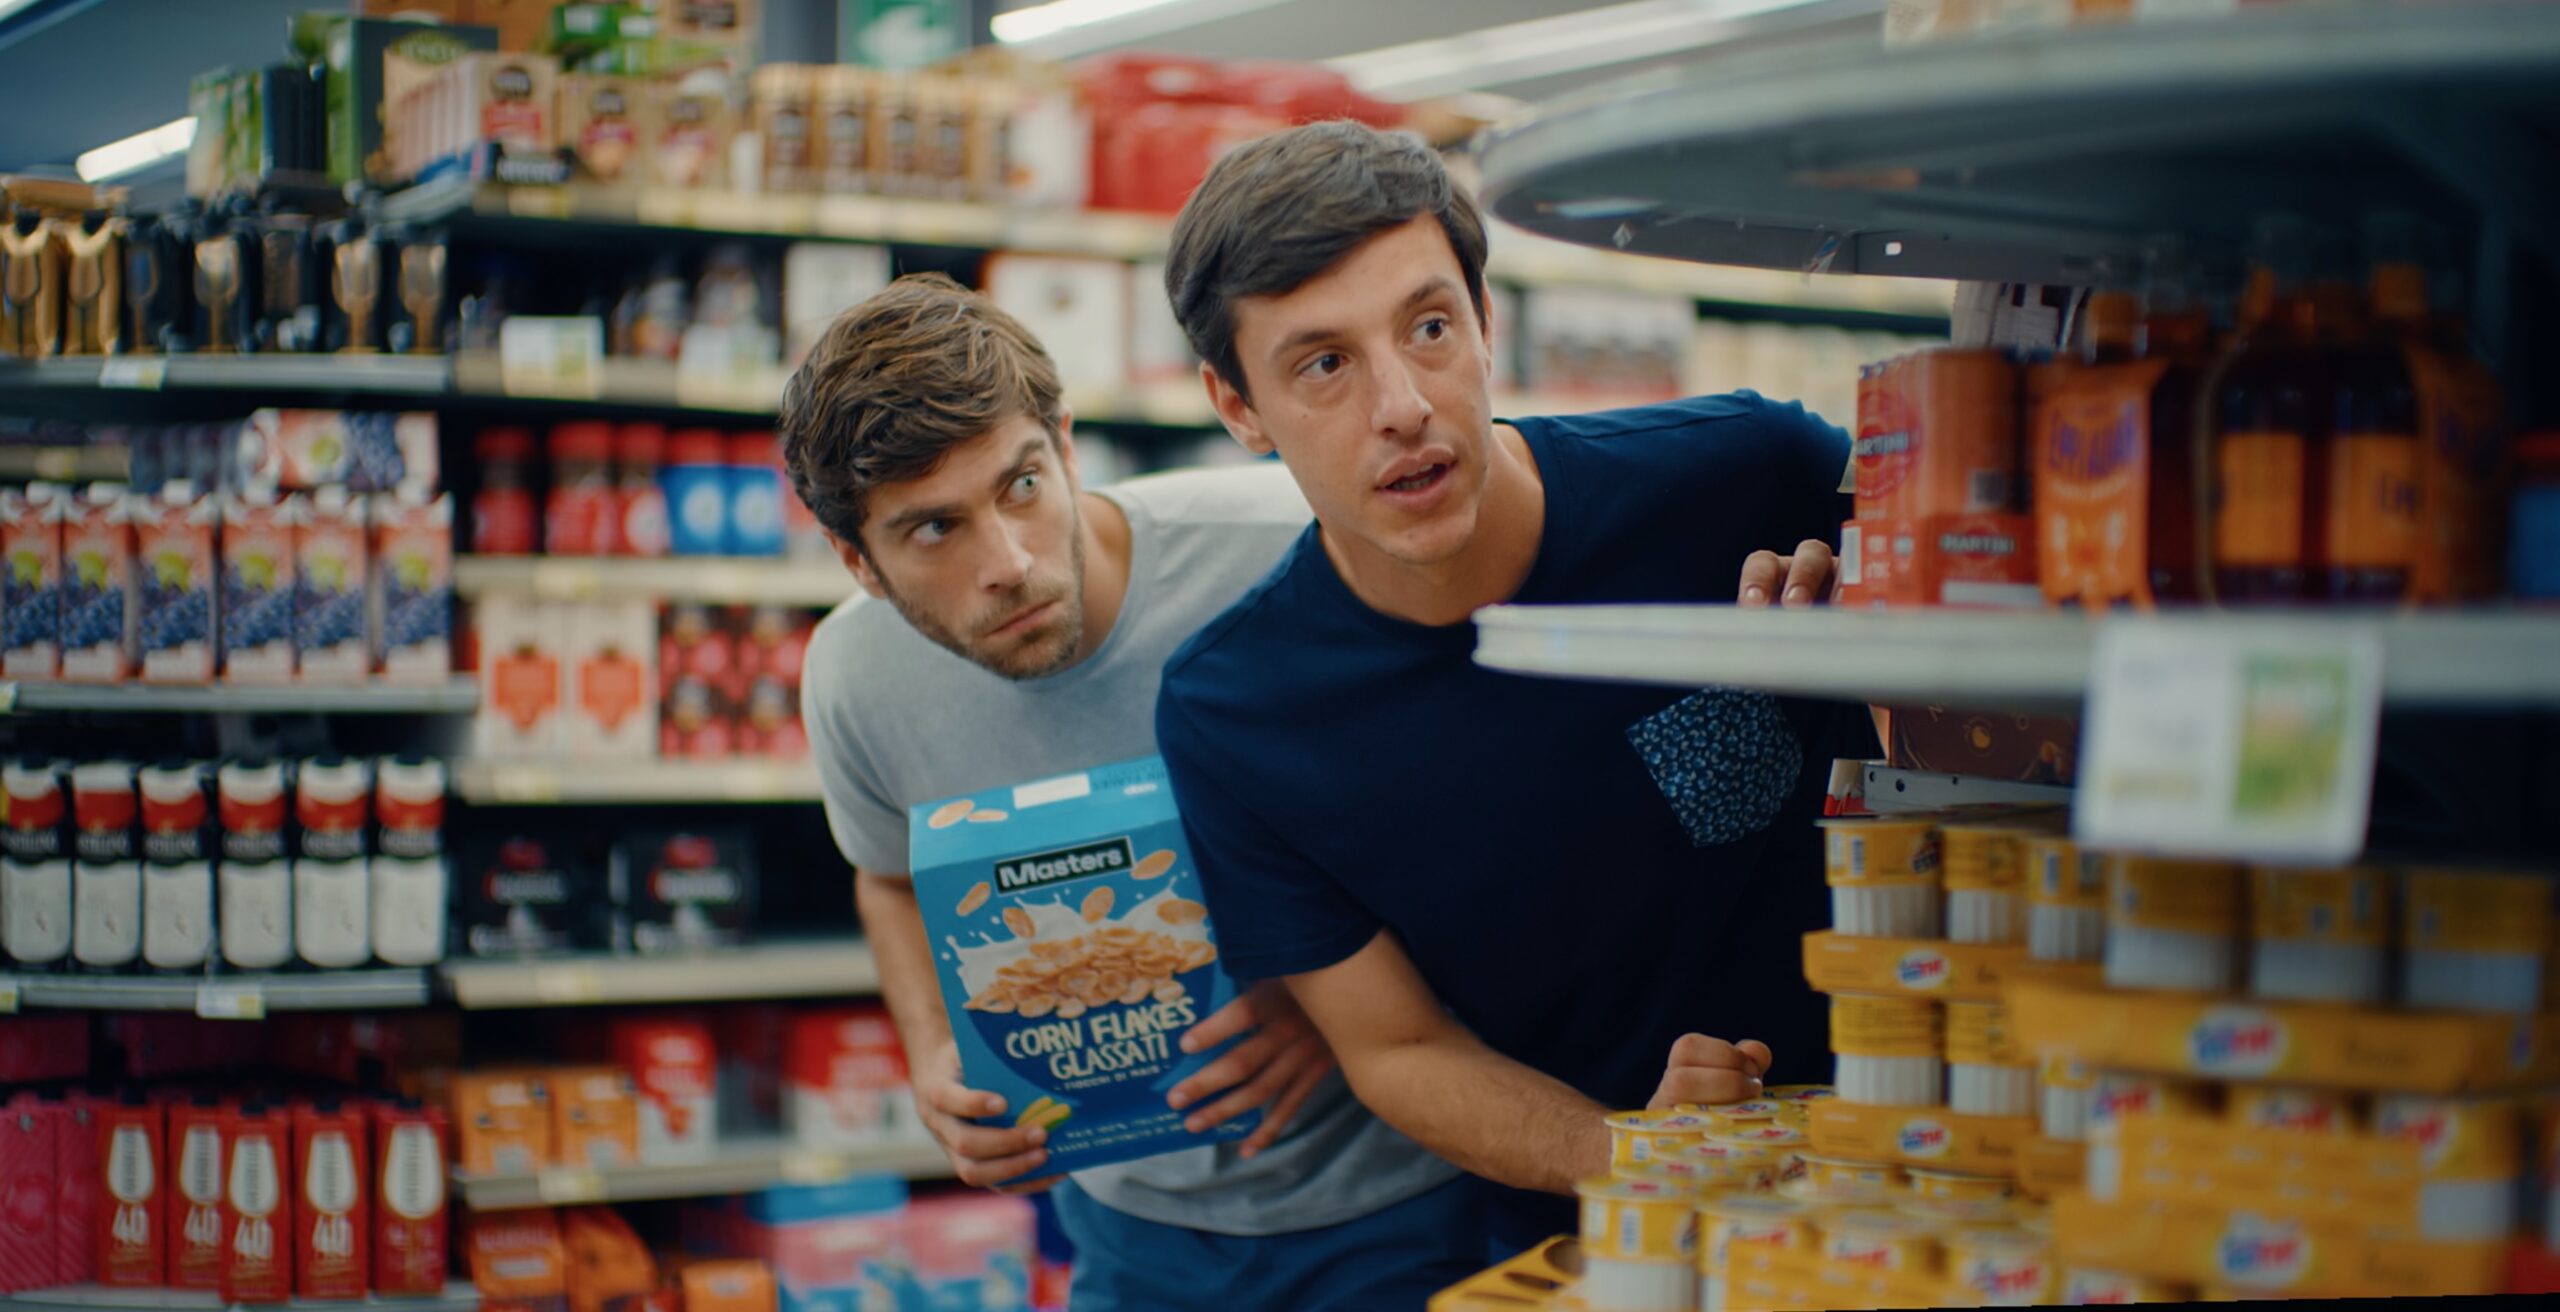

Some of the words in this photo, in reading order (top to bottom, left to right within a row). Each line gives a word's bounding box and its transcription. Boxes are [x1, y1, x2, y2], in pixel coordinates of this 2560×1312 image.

[1856, 431, 1908, 457] ARTINI
[1941, 532, 2015, 555] MARTINI
[999, 848, 1123, 888] Masters
[1005, 1020, 1083, 1059] CORN
[1089, 997, 1196, 1044] FLAKES
[1049, 1033, 1169, 1080] GLASSATI
